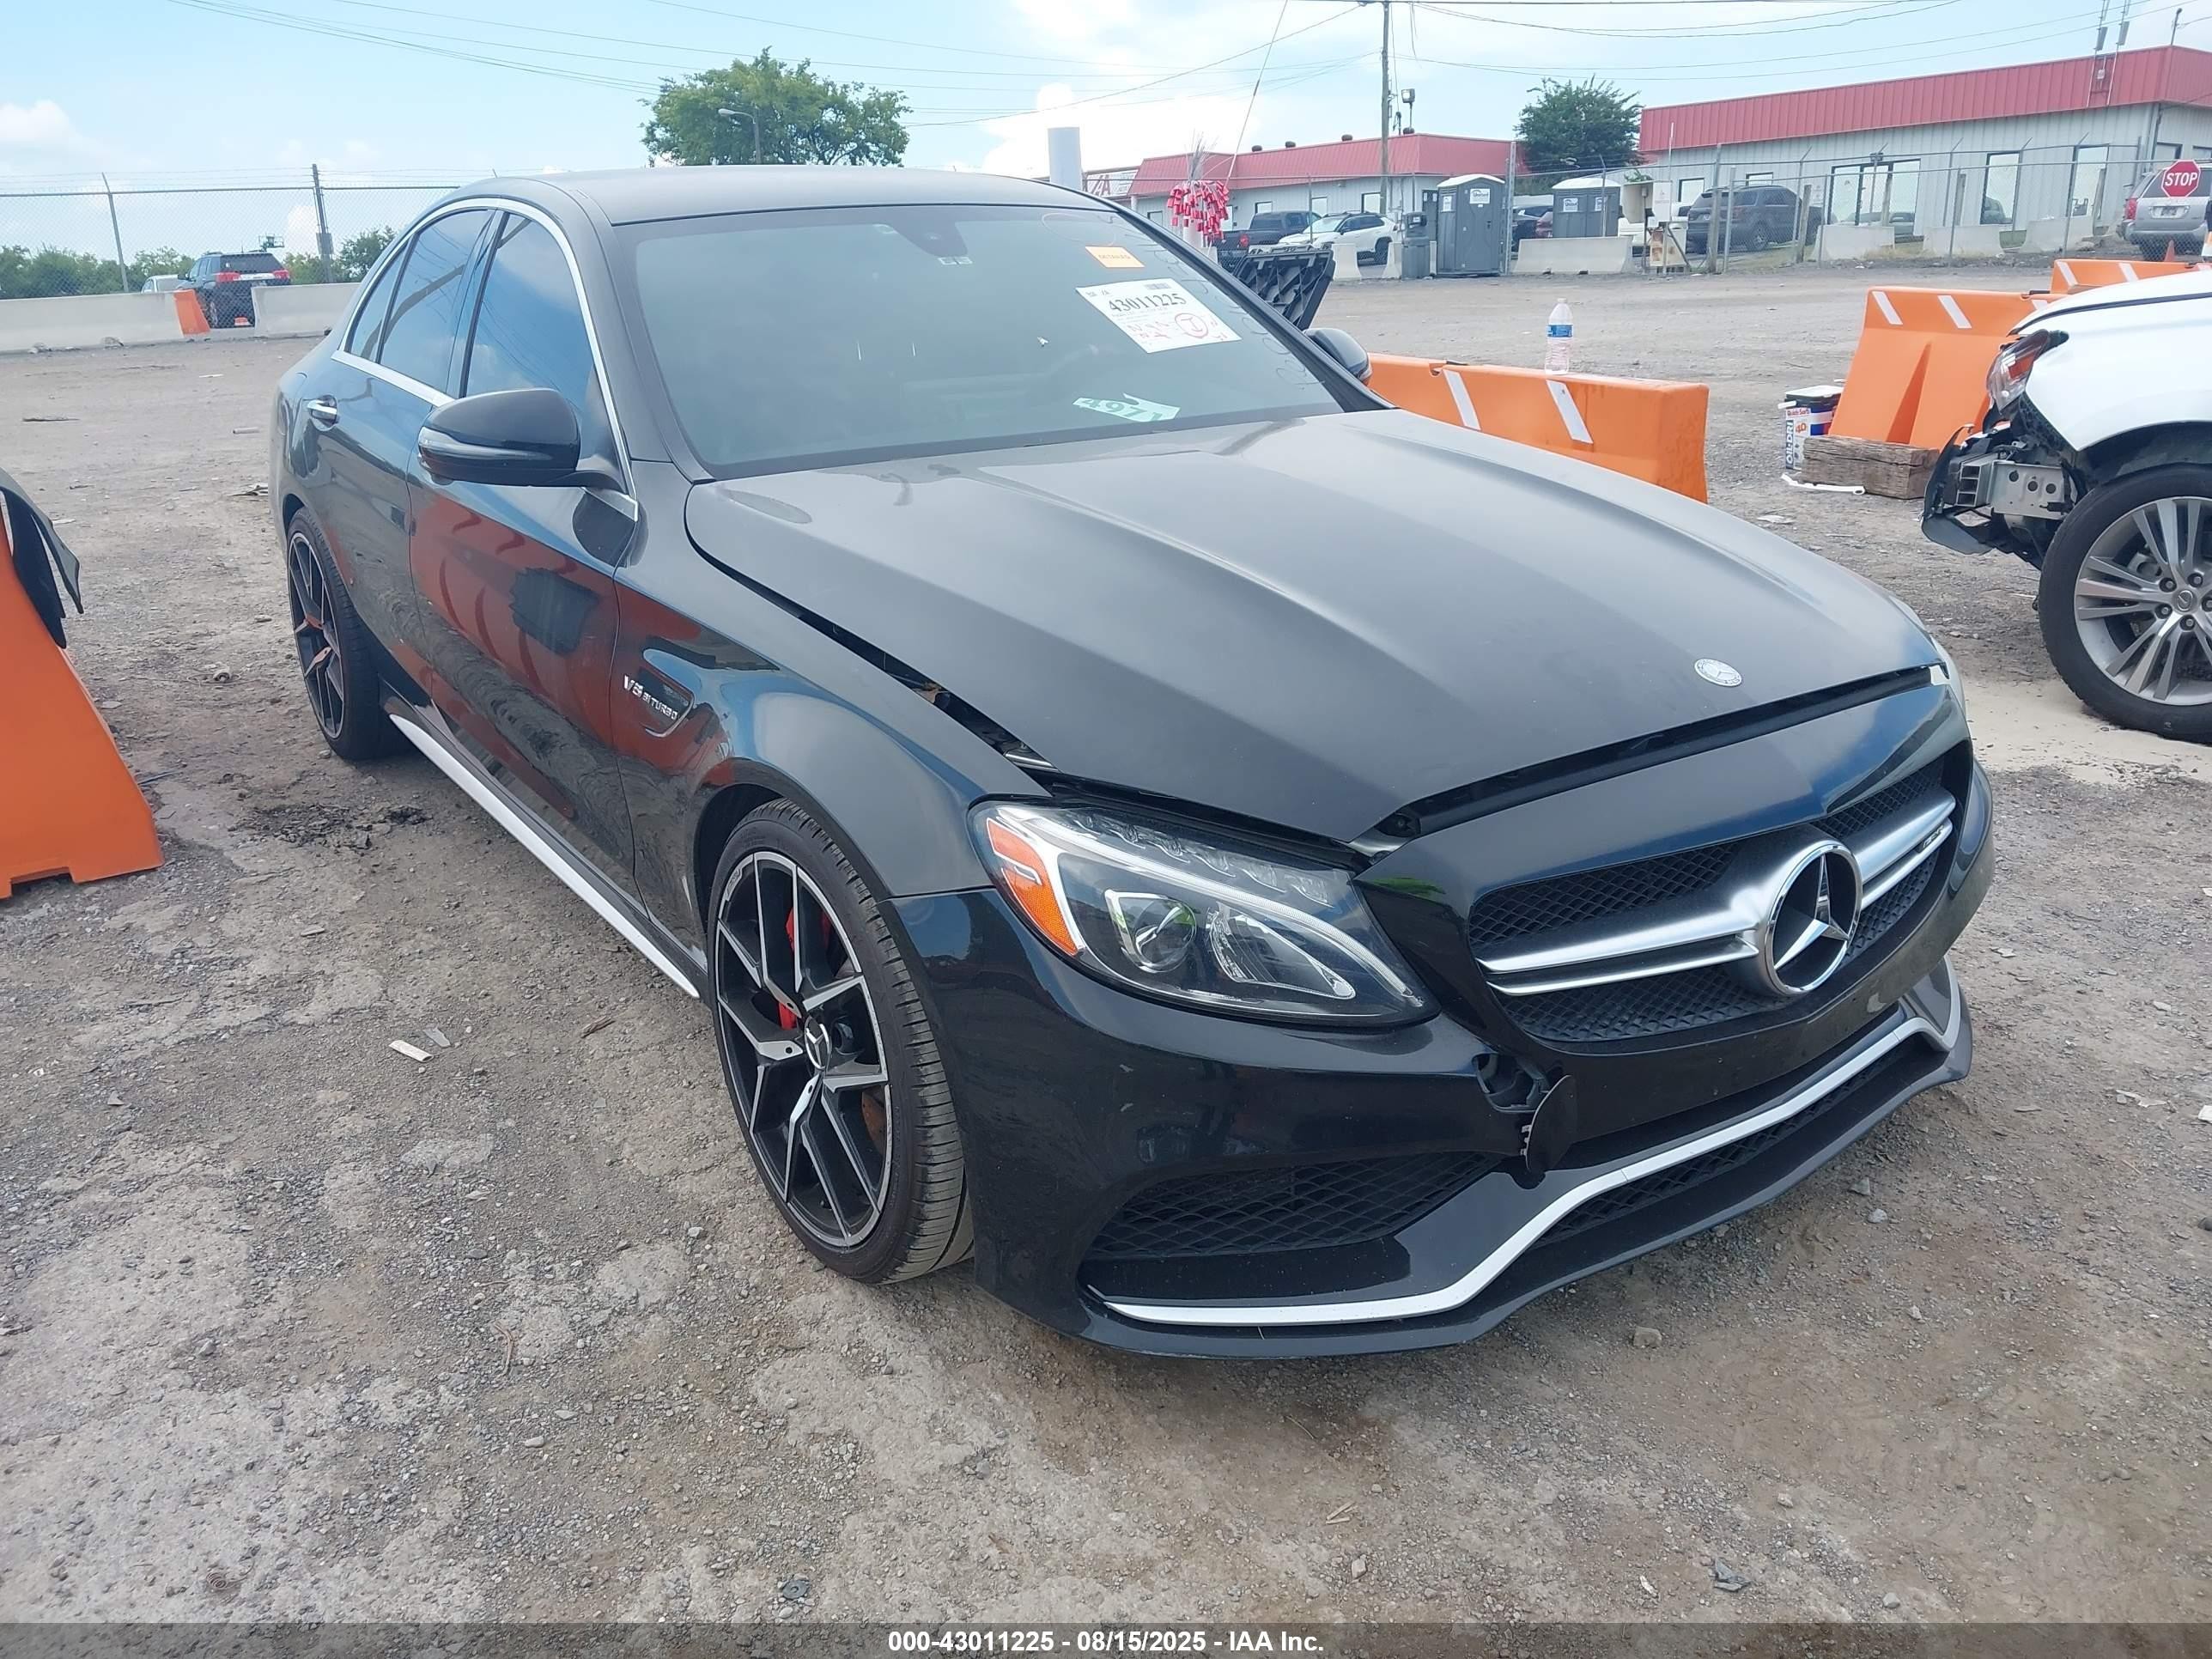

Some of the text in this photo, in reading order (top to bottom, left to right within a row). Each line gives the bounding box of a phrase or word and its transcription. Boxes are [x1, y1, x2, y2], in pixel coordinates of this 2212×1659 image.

[2165, 172, 2198, 186] STOP
[1108, 293, 1188, 313] 43011225
[623, 674, 644, 698] V8
